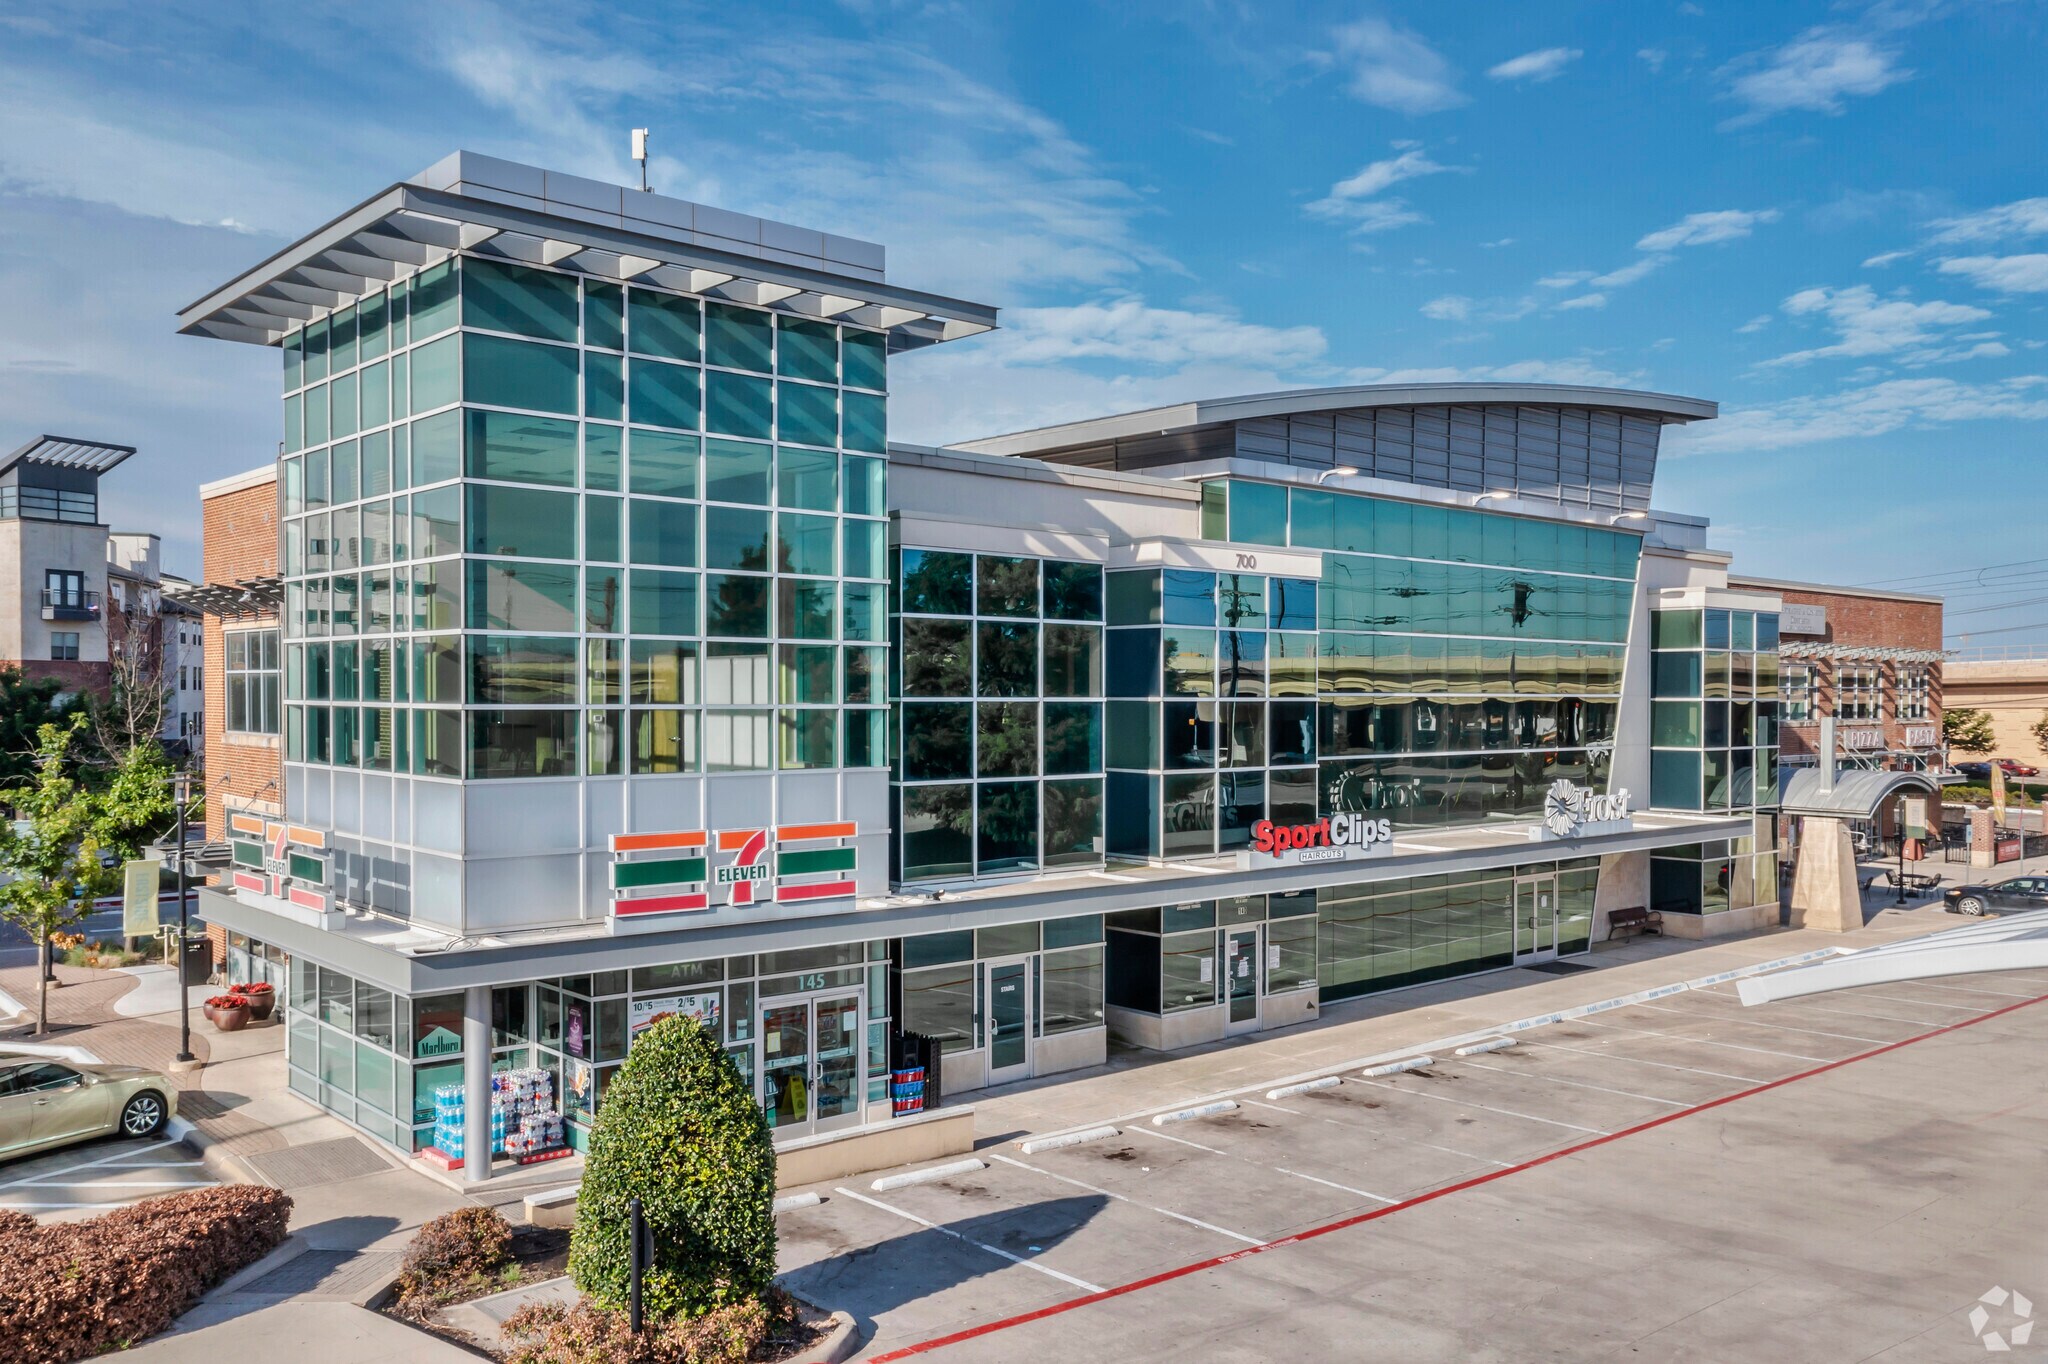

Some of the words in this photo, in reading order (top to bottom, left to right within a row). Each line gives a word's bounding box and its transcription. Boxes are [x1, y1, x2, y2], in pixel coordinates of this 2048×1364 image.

[1236, 554, 1257, 569] 700
[1852, 731, 1879, 747] PIZZA
[1910, 728, 1936, 745] PASTA
[1576, 786, 1632, 822] Frost
[1301, 850, 1342, 860] HAIRCUTS
[716, 827, 768, 906] 7
[672, 963, 703, 978] ATM
[799, 974, 825, 990] 145
[421, 1035, 459, 1055] Marlboro
